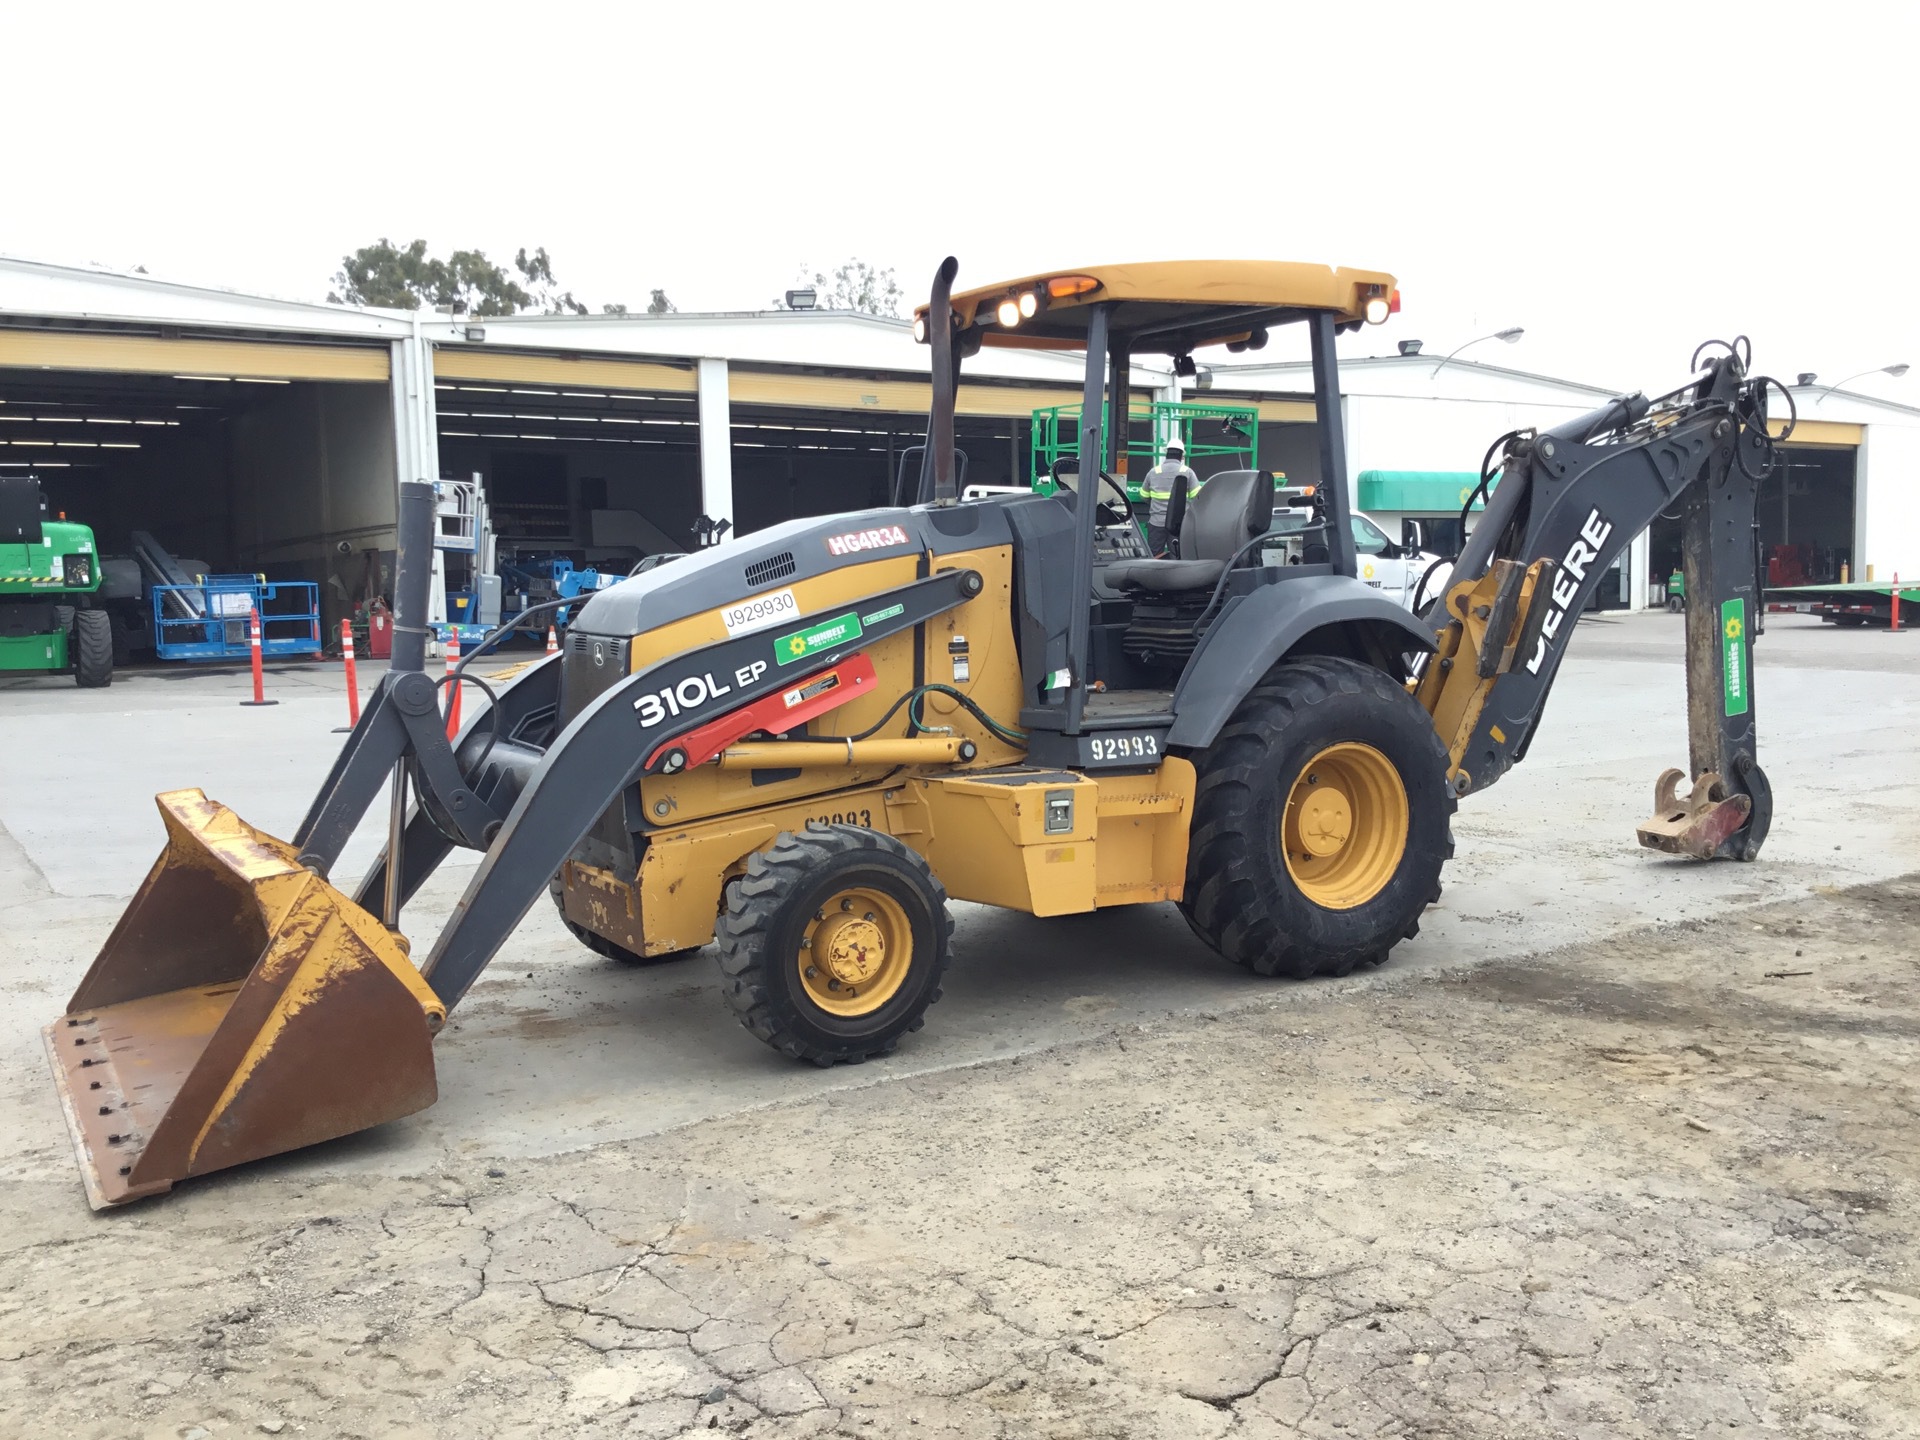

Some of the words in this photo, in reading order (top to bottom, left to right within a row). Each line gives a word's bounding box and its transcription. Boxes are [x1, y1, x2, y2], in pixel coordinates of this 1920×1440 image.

[828, 526, 906, 555] HG4R34
[727, 593, 794, 628] J929930
[806, 624, 846, 646] SUNBELT
[814, 634, 842, 647] RENTALS
[1730, 641, 1741, 699] SUNBELT
[633, 673, 731, 728] 310L
[735, 660, 768, 688] EP
[1091, 735, 1158, 761] 92993
